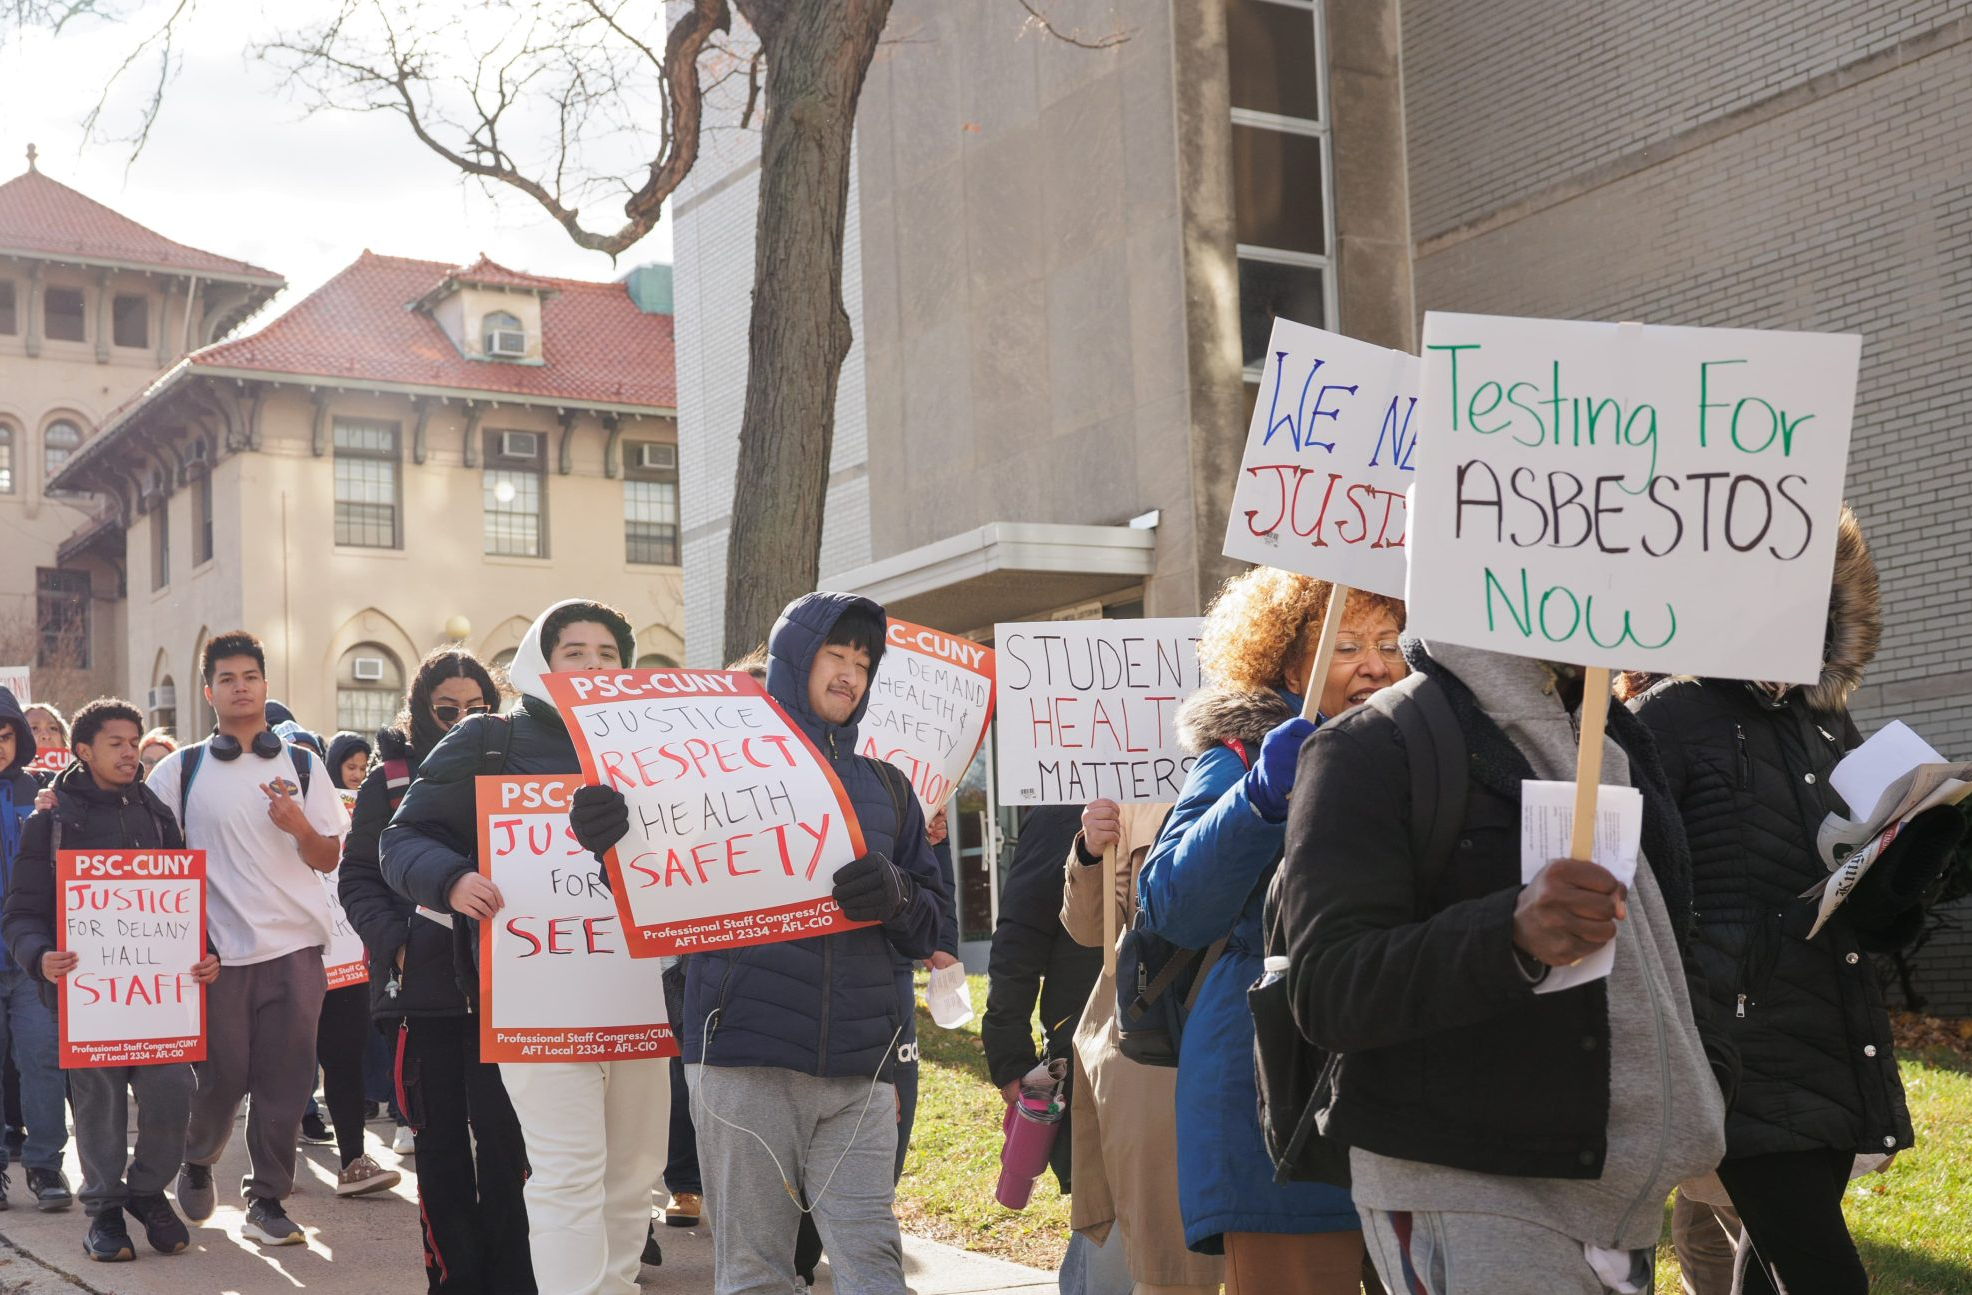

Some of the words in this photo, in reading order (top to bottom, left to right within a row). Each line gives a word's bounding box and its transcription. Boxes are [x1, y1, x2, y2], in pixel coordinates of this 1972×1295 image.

[1263, 351, 1359, 454] WE
[1427, 344, 1658, 495] Testing
[1456, 459, 1813, 561] ASBESTOS
[886, 623, 985, 669] C-CUNY
[571, 673, 739, 700] PSC-CUNY
[877, 672, 955, 722] HEALTH
[907, 657, 985, 708] DEMAND
[585, 705, 763, 737] JUSTICE
[867, 703, 959, 760] SAFETY
[1030, 696, 1184, 753] HEALT
[600, 735, 798, 793] RESPECT
[638, 780, 797, 840] HEALTH
[75, 854, 194, 876] PSC-CUNY
[629, 813, 830, 888] SAFETY
[68, 884, 191, 914] JUSTICE
[551, 868, 608, 900] FOR
[67, 918, 104, 938] FOR
[117, 918, 190, 940] DELANY
[506, 915, 617, 958] SEE
[642, 921, 721, 940] Professional
[723, 915, 755, 930] Staff
[675, 936, 698, 948] AFT
[700, 930, 734, 944] Local
[736, 928, 770, 940] 2334
[780, 915, 834, 934] AFL-CIO
[101, 945, 161, 966] HALL
[74, 972, 193, 1006] STAFF
[71, 1044, 122, 1053] Professional
[124, 1042, 142, 1051] Staff
[143, 1039, 198, 1051] Congress/CUNY
[497, 1033, 565, 1044] Professional
[567, 1032, 594, 1043] Staff
[521, 1045, 543, 1056] AFT
[545, 1045, 574, 1056] Local
[577, 1044, 605, 1054] 2334
[614, 1041, 658, 1053] AFL-CIO
[90, 1053, 107, 1062] AFT
[108, 1052, 128, 1061] Local
[130, 1051, 150, 1060] 2334
[156, 1049, 184, 1059] AFL-CIO
